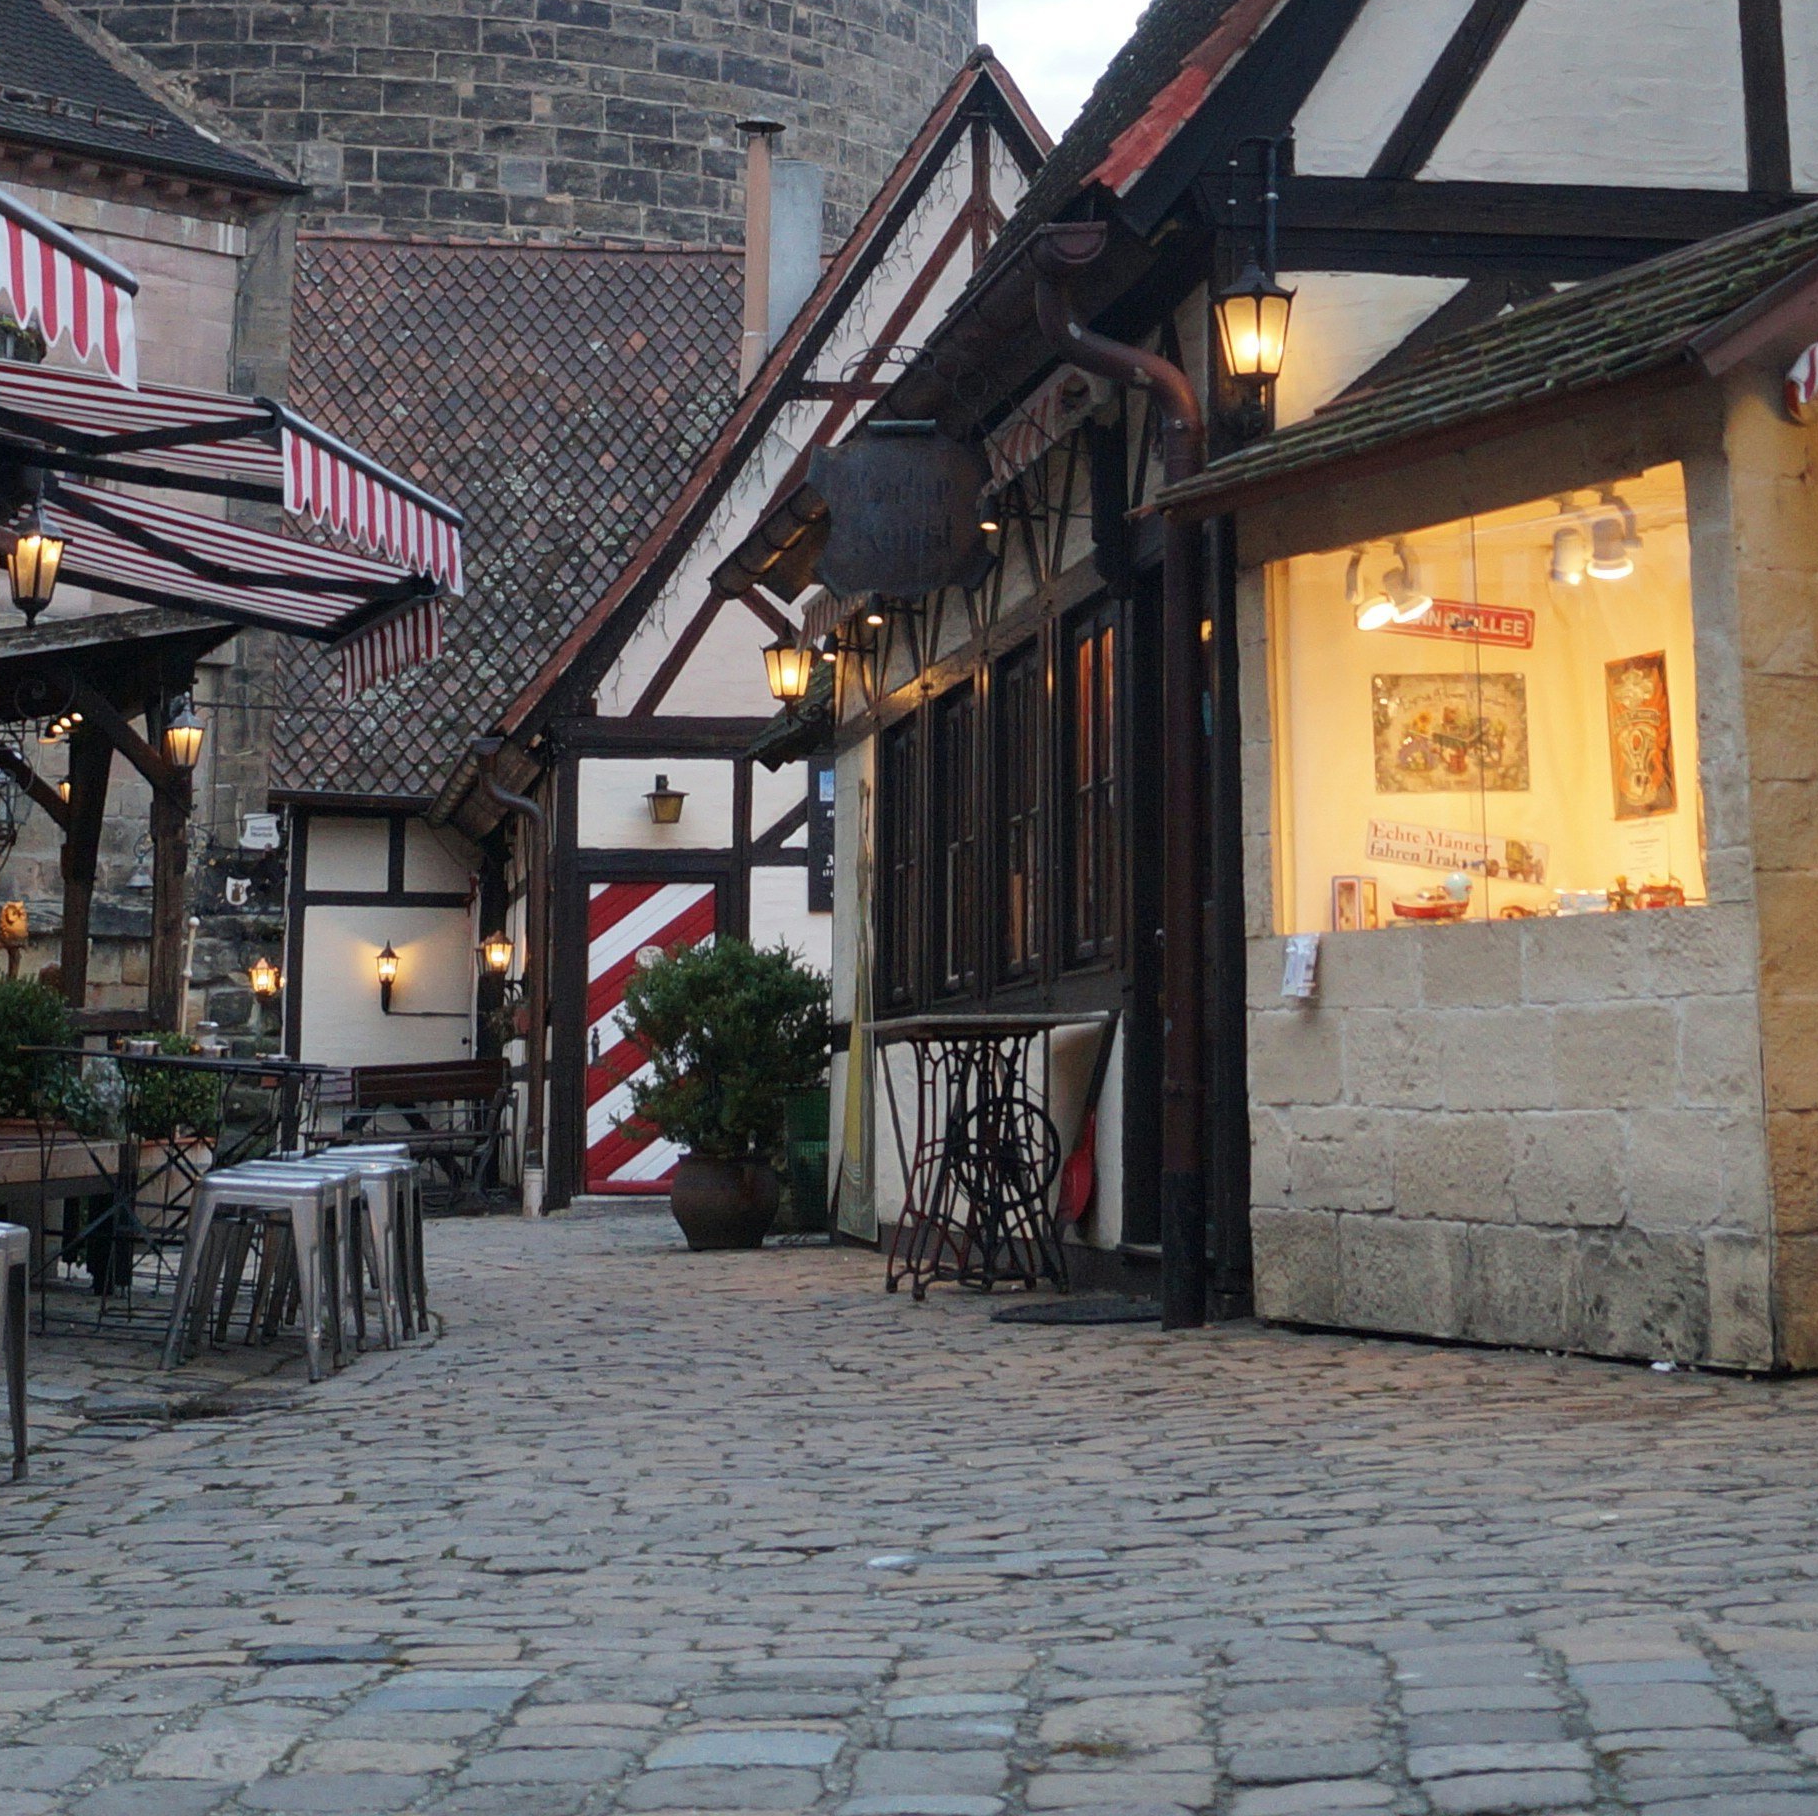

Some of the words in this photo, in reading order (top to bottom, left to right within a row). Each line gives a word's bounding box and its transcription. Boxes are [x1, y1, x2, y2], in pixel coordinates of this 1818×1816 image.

[1369, 840, 1421, 864] fahren
[1372, 822, 1421, 845] Echte
[1425, 829, 1492, 855] Männer
